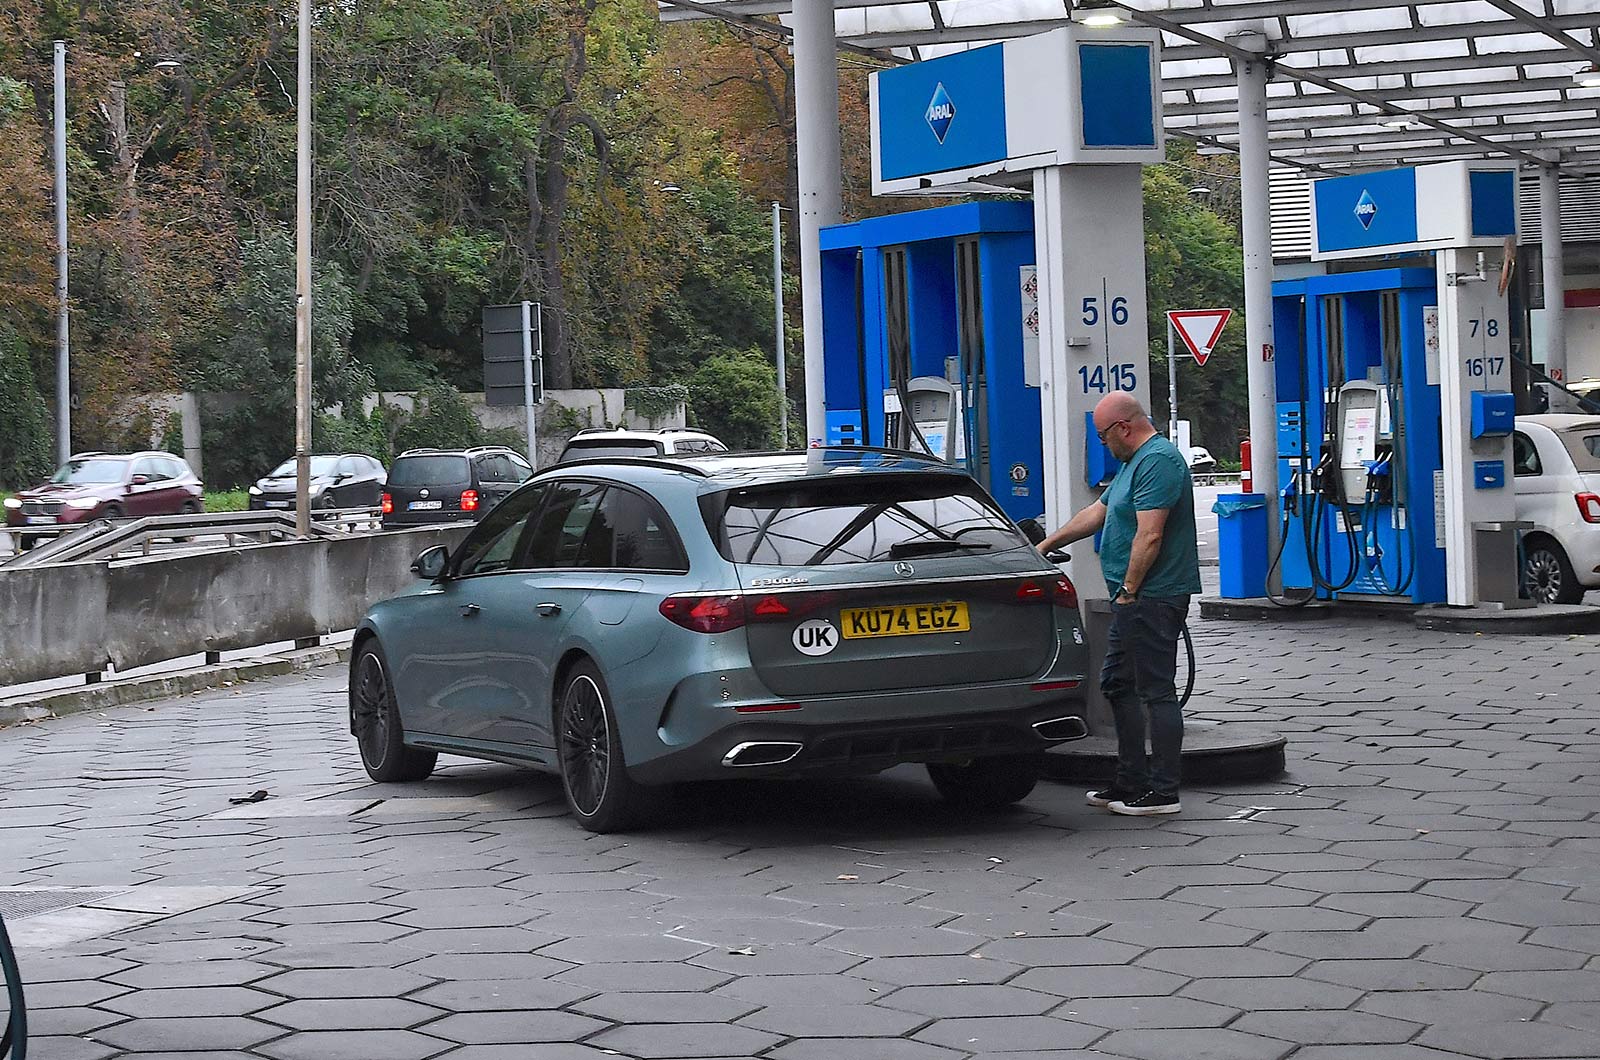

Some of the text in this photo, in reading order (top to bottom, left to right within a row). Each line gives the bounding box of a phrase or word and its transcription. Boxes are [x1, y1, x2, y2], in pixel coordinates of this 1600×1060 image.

[929, 103, 952, 121] ARAL
[1357, 203, 1375, 215] ARAL
[1083, 297, 1128, 326] 5 6
[1469, 319, 1498, 338] 7 8
[1466, 357, 1504, 376] 16 17
[1078, 363, 1136, 394] 14 15
[852, 606, 959, 634] KU74 EGZ
[799, 627, 832, 648] UK
